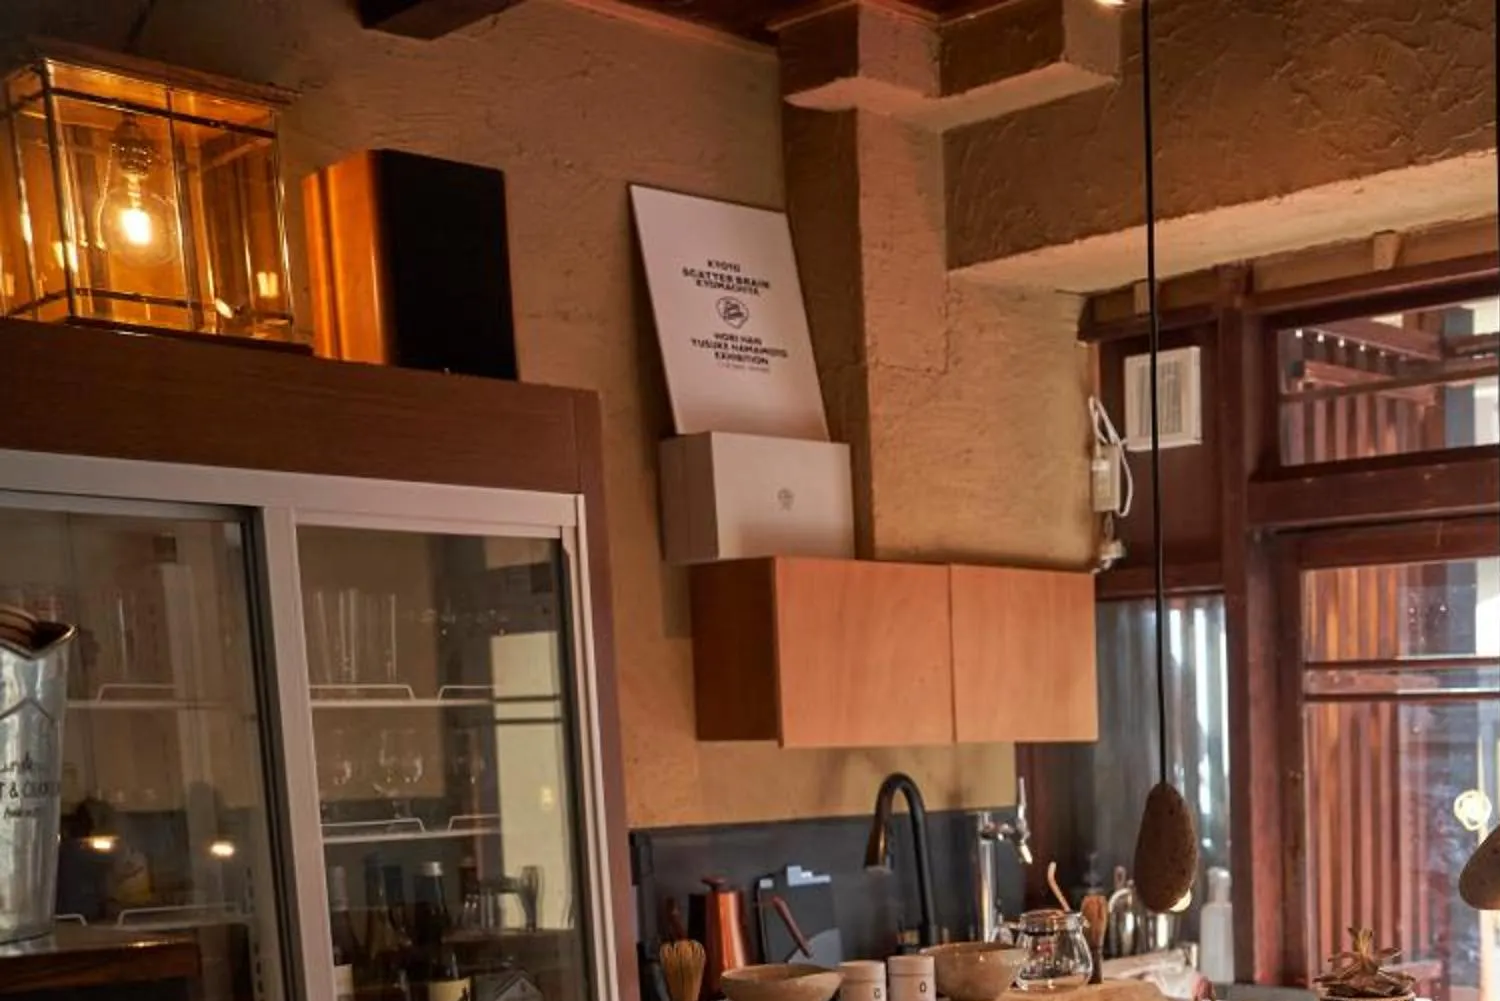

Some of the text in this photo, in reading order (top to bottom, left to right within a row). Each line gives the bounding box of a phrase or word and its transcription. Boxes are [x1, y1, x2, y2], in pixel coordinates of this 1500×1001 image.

[707, 260, 740, 272] KYOTO
[682, 267, 770, 289] SCATTER BRAIN
[715, 351, 768, 365] EXHIBITION
